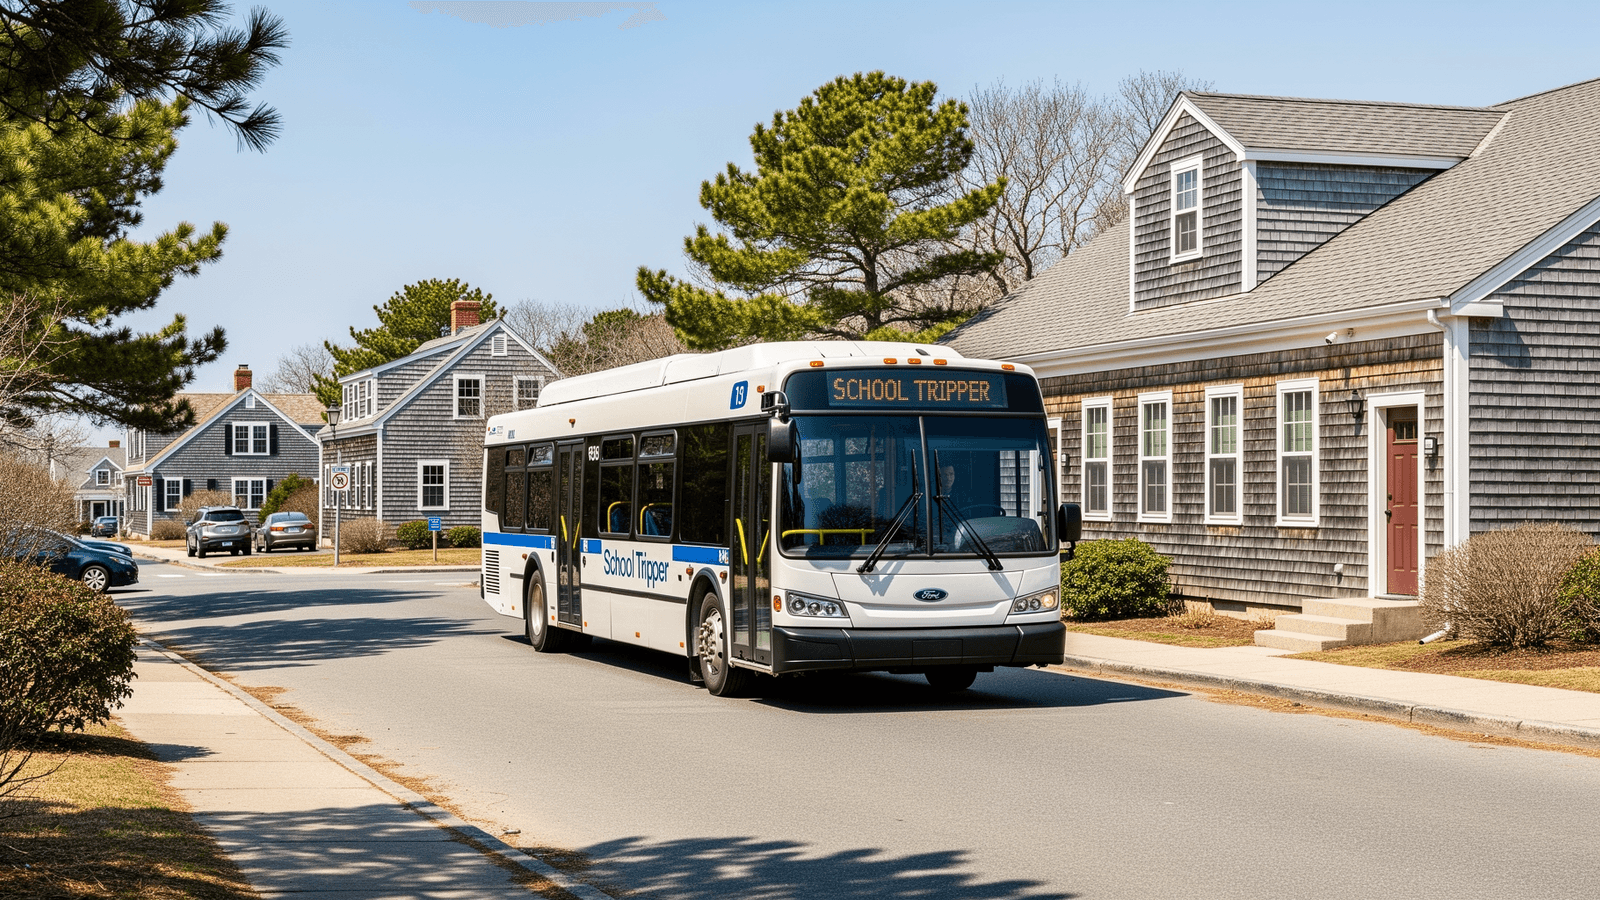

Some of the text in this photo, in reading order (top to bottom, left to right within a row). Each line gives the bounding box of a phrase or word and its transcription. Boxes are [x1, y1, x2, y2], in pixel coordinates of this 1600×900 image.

[833, 378, 990, 402] SCHOOL TRIPPER
[603, 549, 669, 588] School Tripper
[921, 590, 940, 599] Ford
